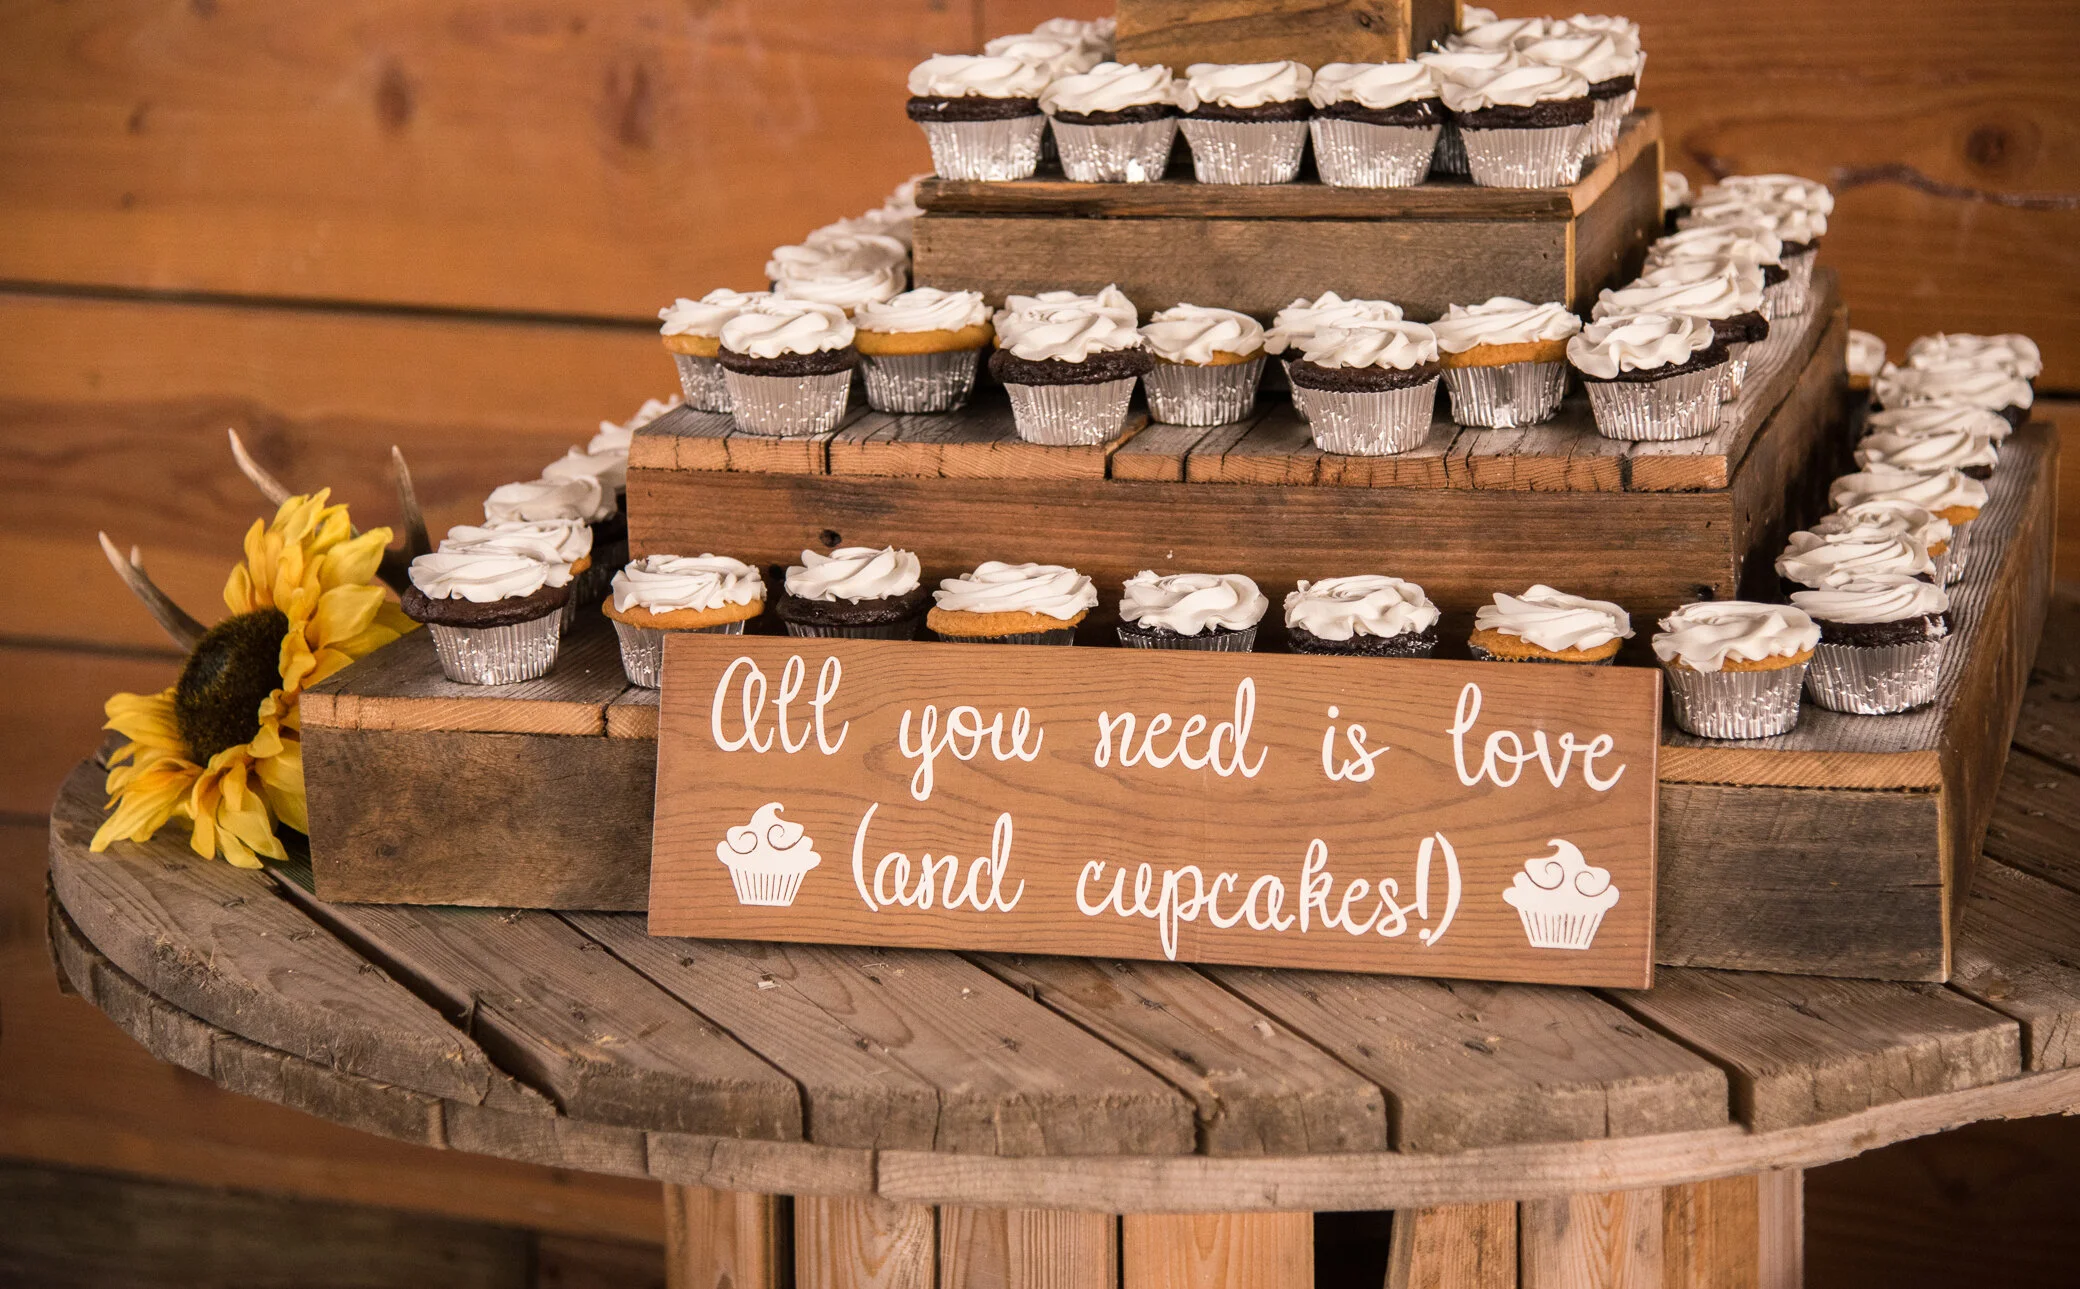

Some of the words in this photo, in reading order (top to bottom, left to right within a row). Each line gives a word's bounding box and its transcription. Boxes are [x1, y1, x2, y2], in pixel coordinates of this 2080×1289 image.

[712, 655, 849, 756] All
[899, 704, 1044, 802] you
[1094, 676, 1268, 779] need
[1322, 705, 1390, 783] is
[1446, 682, 1627, 792] love
[852, 802, 1025, 913] (and
[1076, 831, 1463, 962] cupcakes!)
